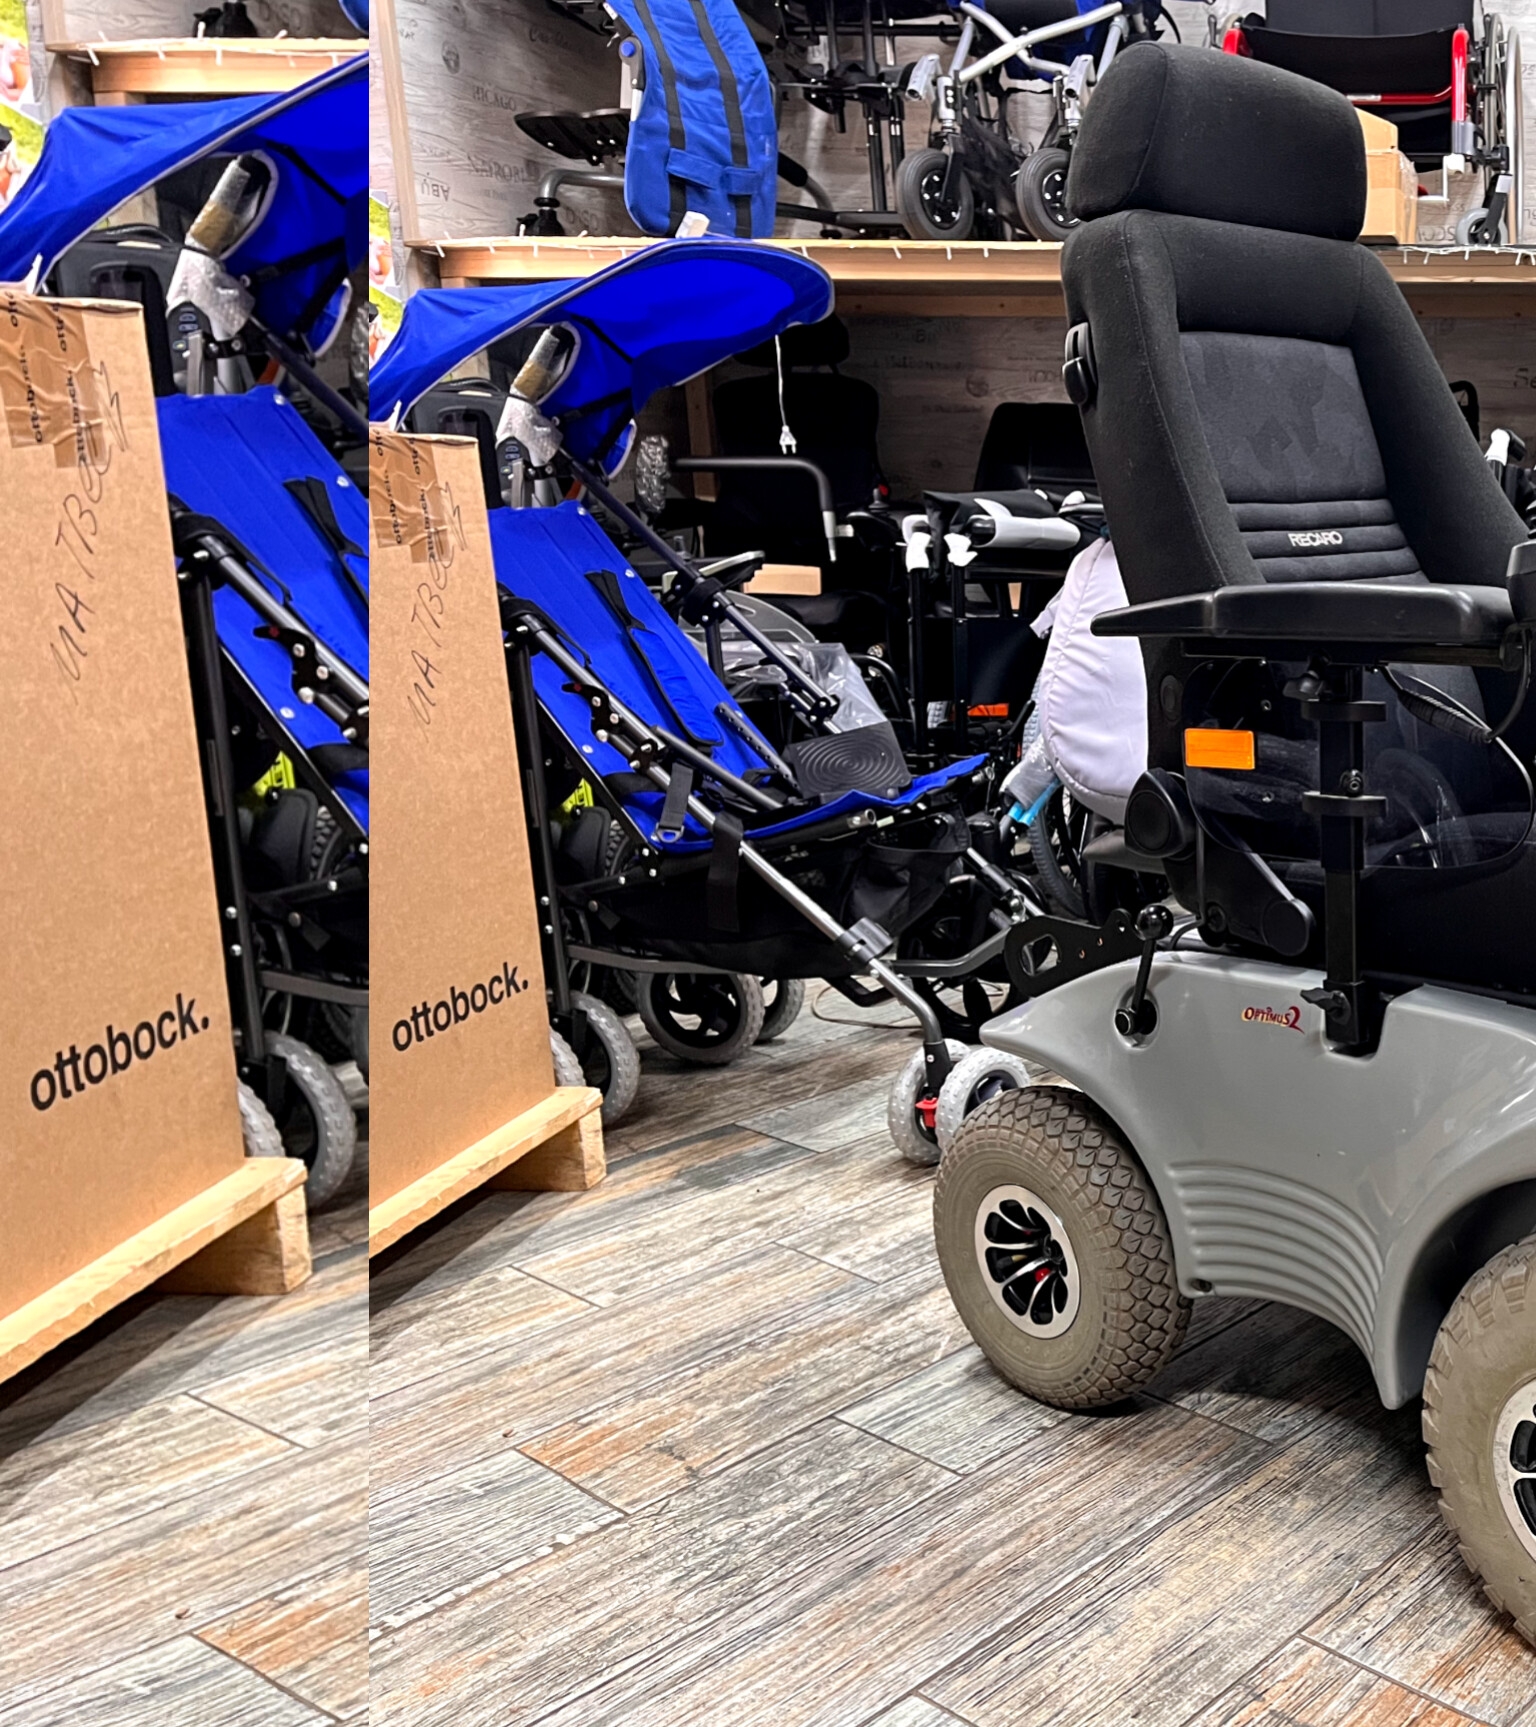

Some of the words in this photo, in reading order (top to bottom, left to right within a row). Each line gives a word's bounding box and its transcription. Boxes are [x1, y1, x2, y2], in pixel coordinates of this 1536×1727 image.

[1287, 531, 1343, 547] RECARO
[30, 993, 210, 1111] ottobock.
[392, 961, 529, 1052] ottobock.
